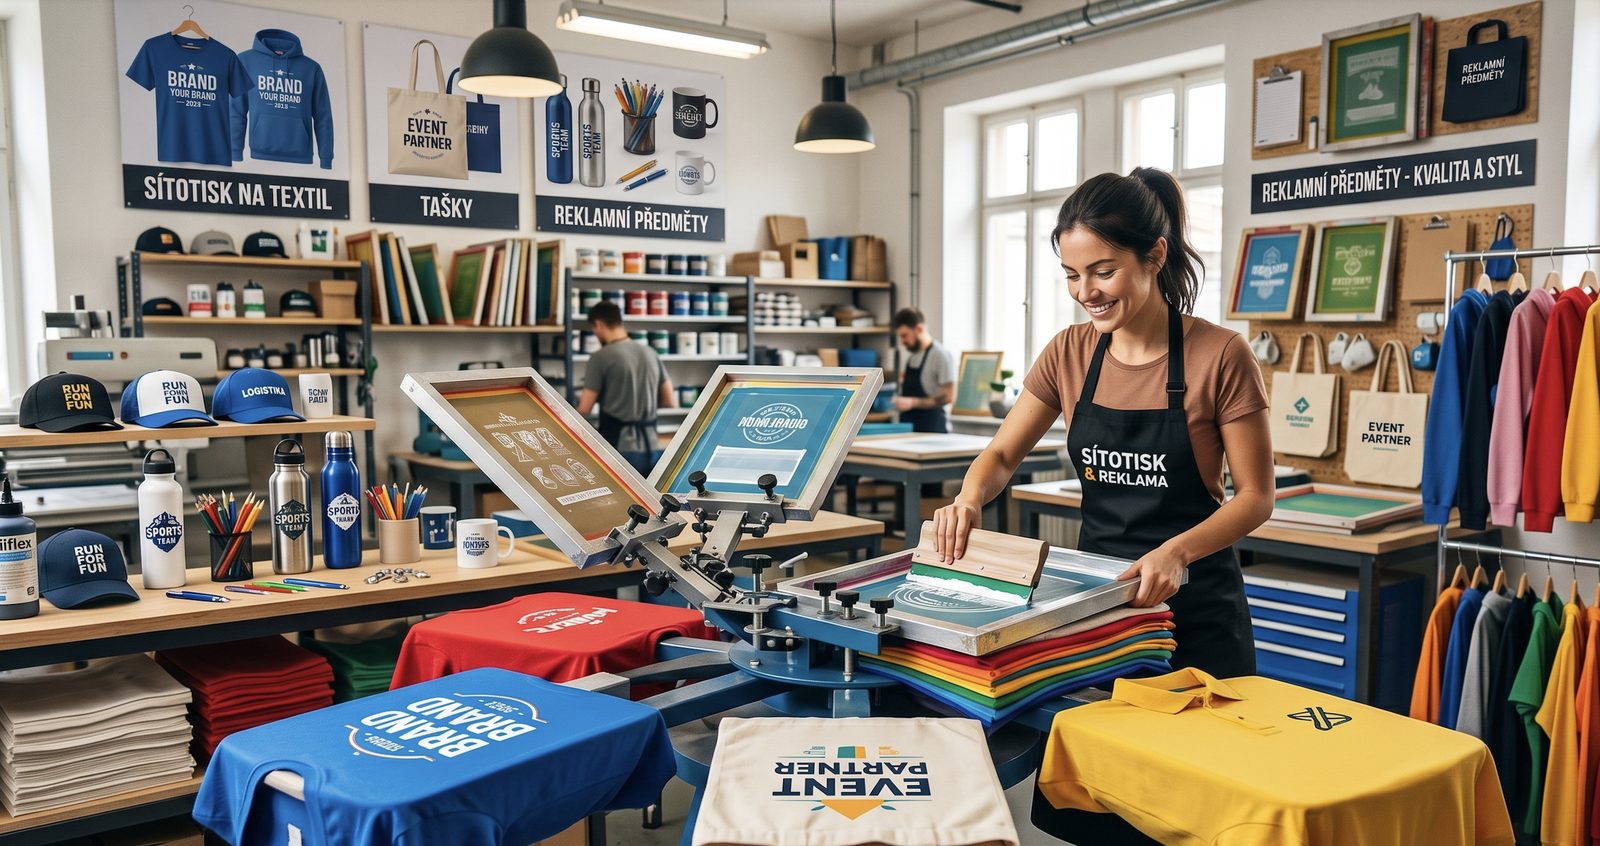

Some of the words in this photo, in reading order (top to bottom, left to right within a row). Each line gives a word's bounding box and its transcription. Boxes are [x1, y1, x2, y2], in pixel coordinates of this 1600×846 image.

[1462, 55, 1506, 74] REKLAMNÍ
[168, 70, 217, 91] BRAND
[258, 75, 303, 94] BRAND
[170, 88, 190, 98] YOUR
[191, 90, 216, 101] BRAND
[259, 91, 278, 102] YOUR
[279, 93, 301, 104] BRAND
[407, 117, 448, 136] EVENT
[403, 133, 452, 151] PARTNER
[583, 123, 592, 159] SPORTS
[1262, 171, 1328, 204] REKLAMNÍ
[1330, 164, 1401, 197] PŘEDMĚTY
[1413, 159, 1470, 187] KVALITA
[1473, 158, 1484, 180] A
[1486, 153, 1523, 179] STYL
[144, 172, 234, 205] SÍTOTISK
[238, 182, 265, 207] NA
[268, 184, 333, 211] TEXTIL
[420, 192, 473, 219] TAŠKY
[554, 204, 631, 229] REKLAMNÍ
[634, 207, 709, 234] PŘEDMĚTY
[62, 383, 90, 394] RUN
[162, 381, 187, 390] RUN
[241, 386, 286, 399] LOGISTIKA
[66, 400, 93, 411] FUN
[165, 395, 190, 405] FUN
[1368, 421, 1405, 434] EVENT
[1361, 433, 1411, 446] PARTNER
[1081, 444, 1167, 472] SÍTOTISK
[1084, 466, 1096, 481] &
[1098, 469, 1169, 488] REKLAMA
[328, 505, 360, 516] SPORTS
[275, 512, 311, 525] SPORTS
[146, 525, 182, 539] SPORTS
[157, 537, 176, 545] TEAM
[73, 543, 104, 556] RUN
[76, 553, 105, 565] FOR
[78, 562, 108, 575] FUN
[405, 696, 537, 742] BRAND
[360, 709, 491, 759] BRAND
[774, 762, 929, 775] PARTNER
[771, 777, 932, 796] EVENT
